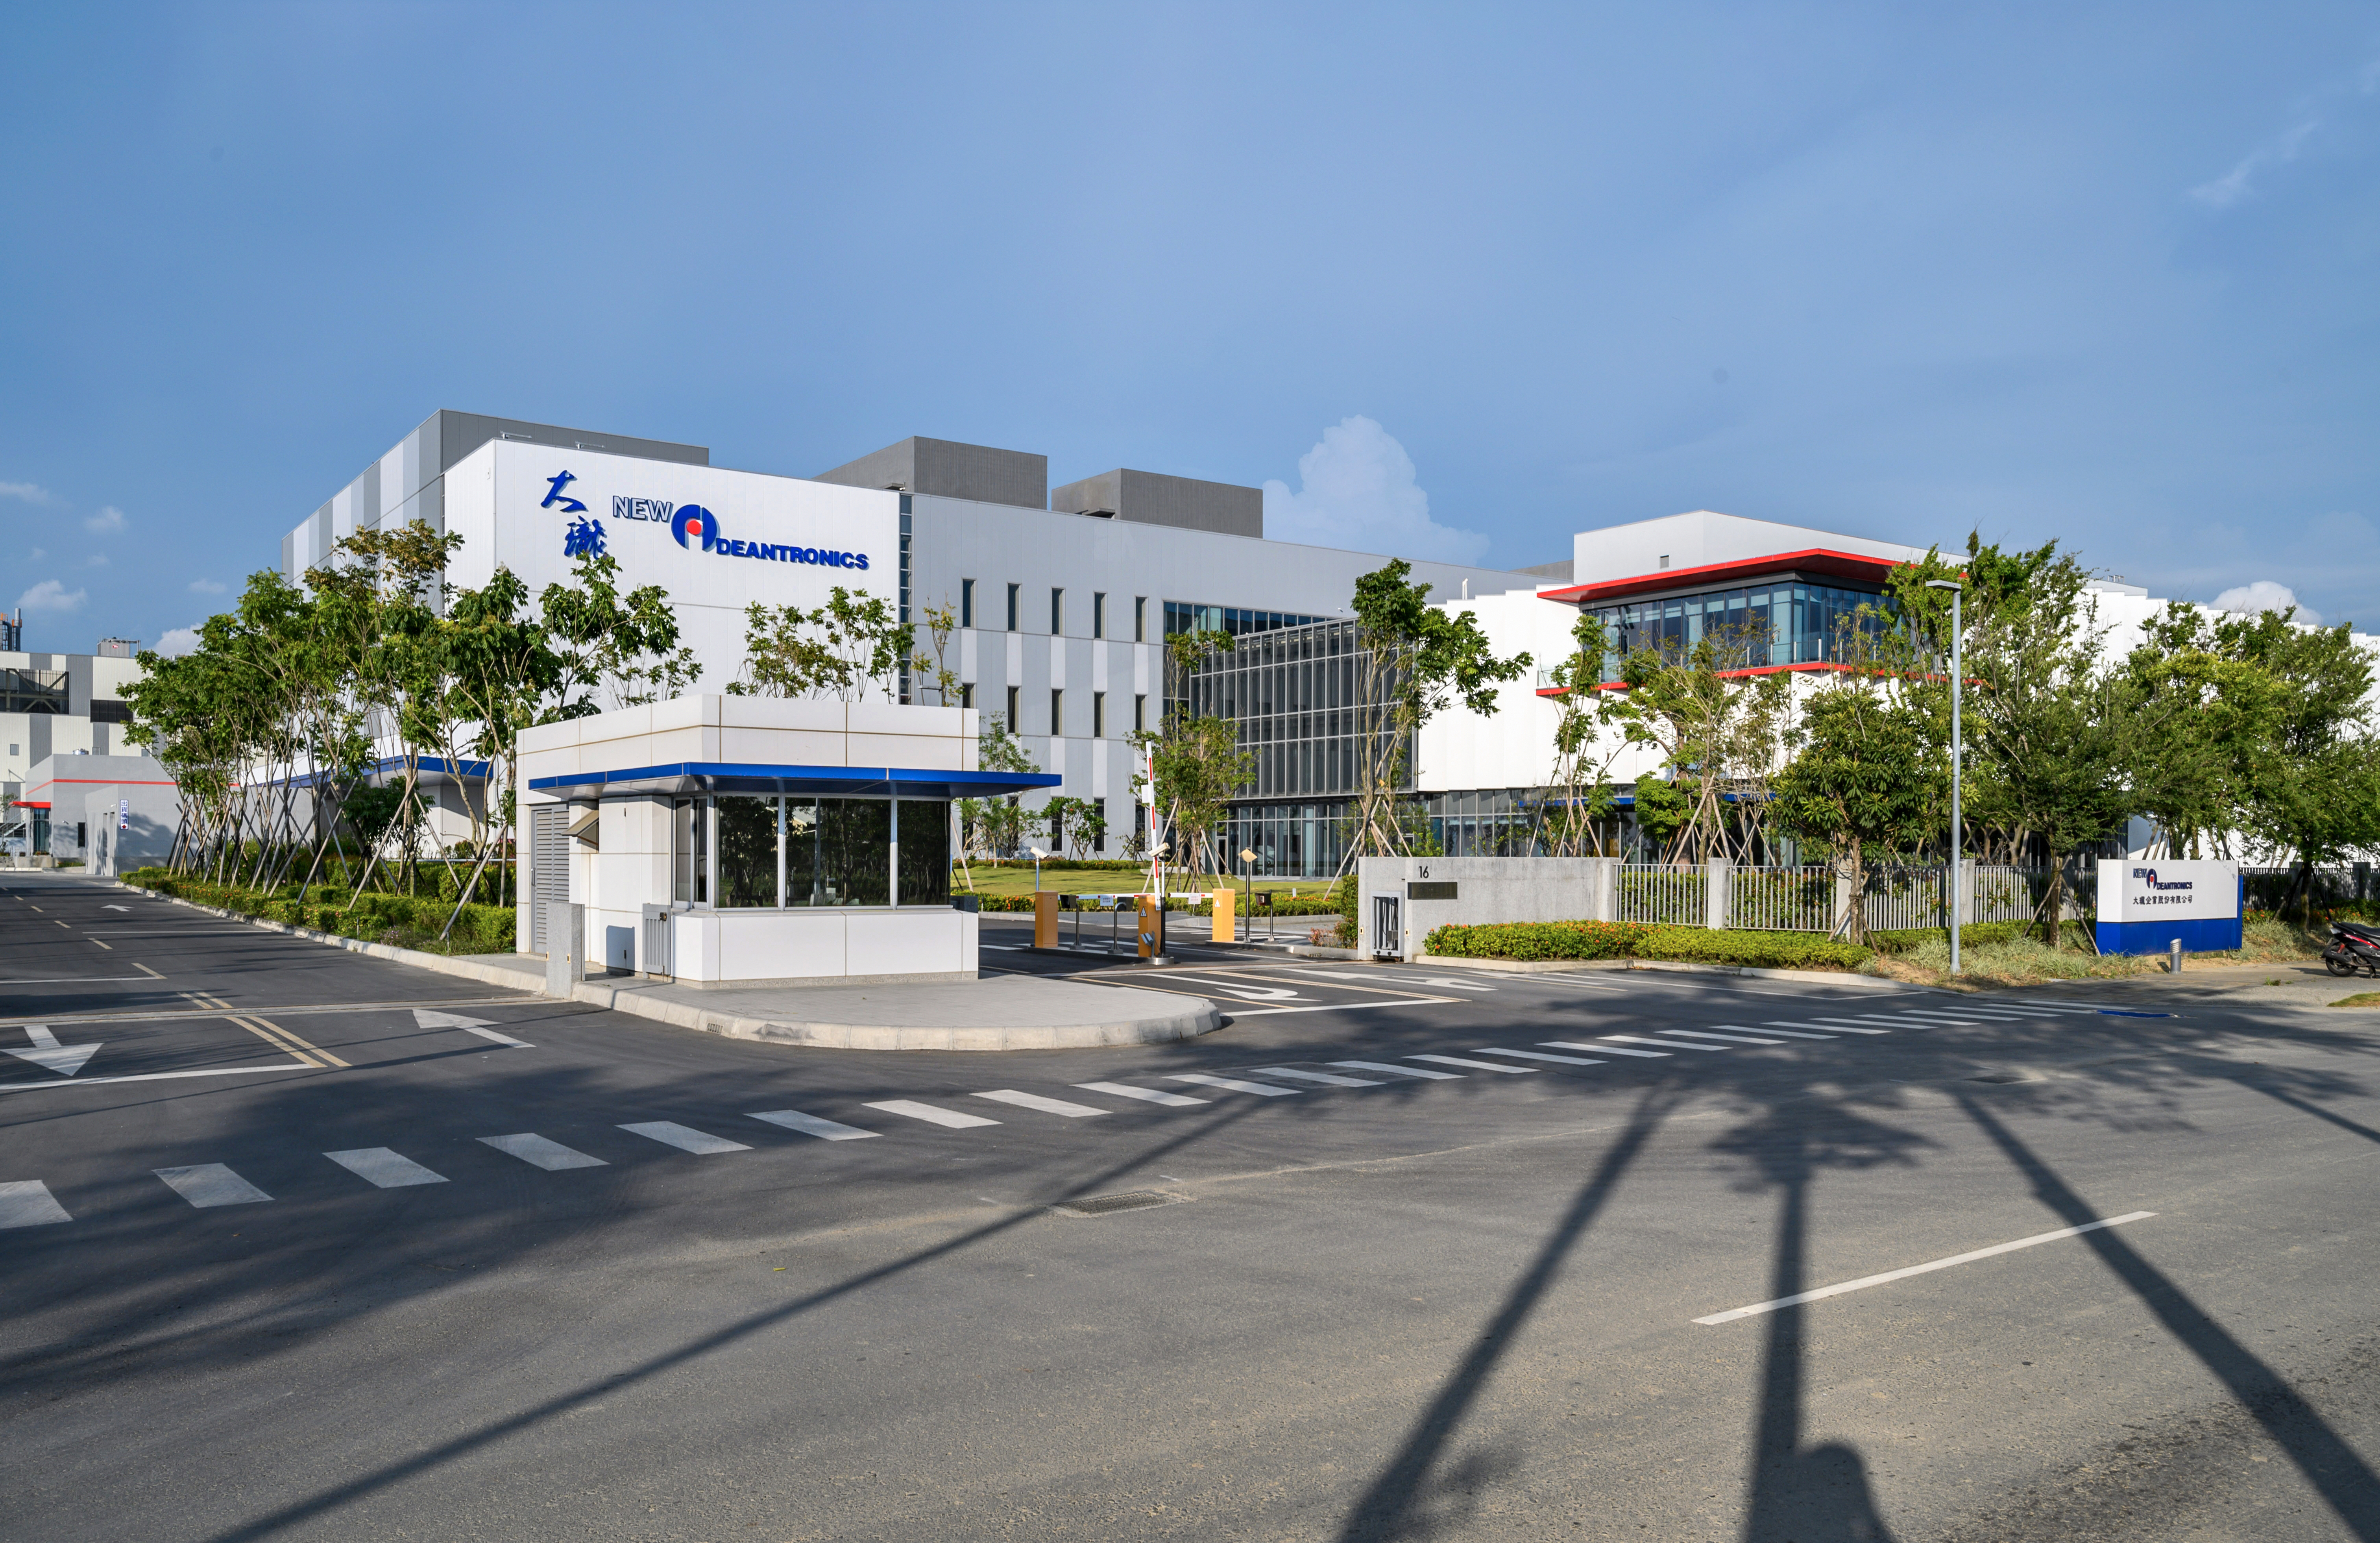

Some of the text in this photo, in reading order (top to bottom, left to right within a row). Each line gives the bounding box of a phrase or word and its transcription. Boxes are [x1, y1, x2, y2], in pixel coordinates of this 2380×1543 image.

[613, 496, 869, 570] NEW DEANTRONICS
[1419, 866, 1429, 878] 16
[2133, 868, 2193, 890] NEW DEANTRONICS
[2133, 895, 2192, 905] 大瓏企業股份有限公司
